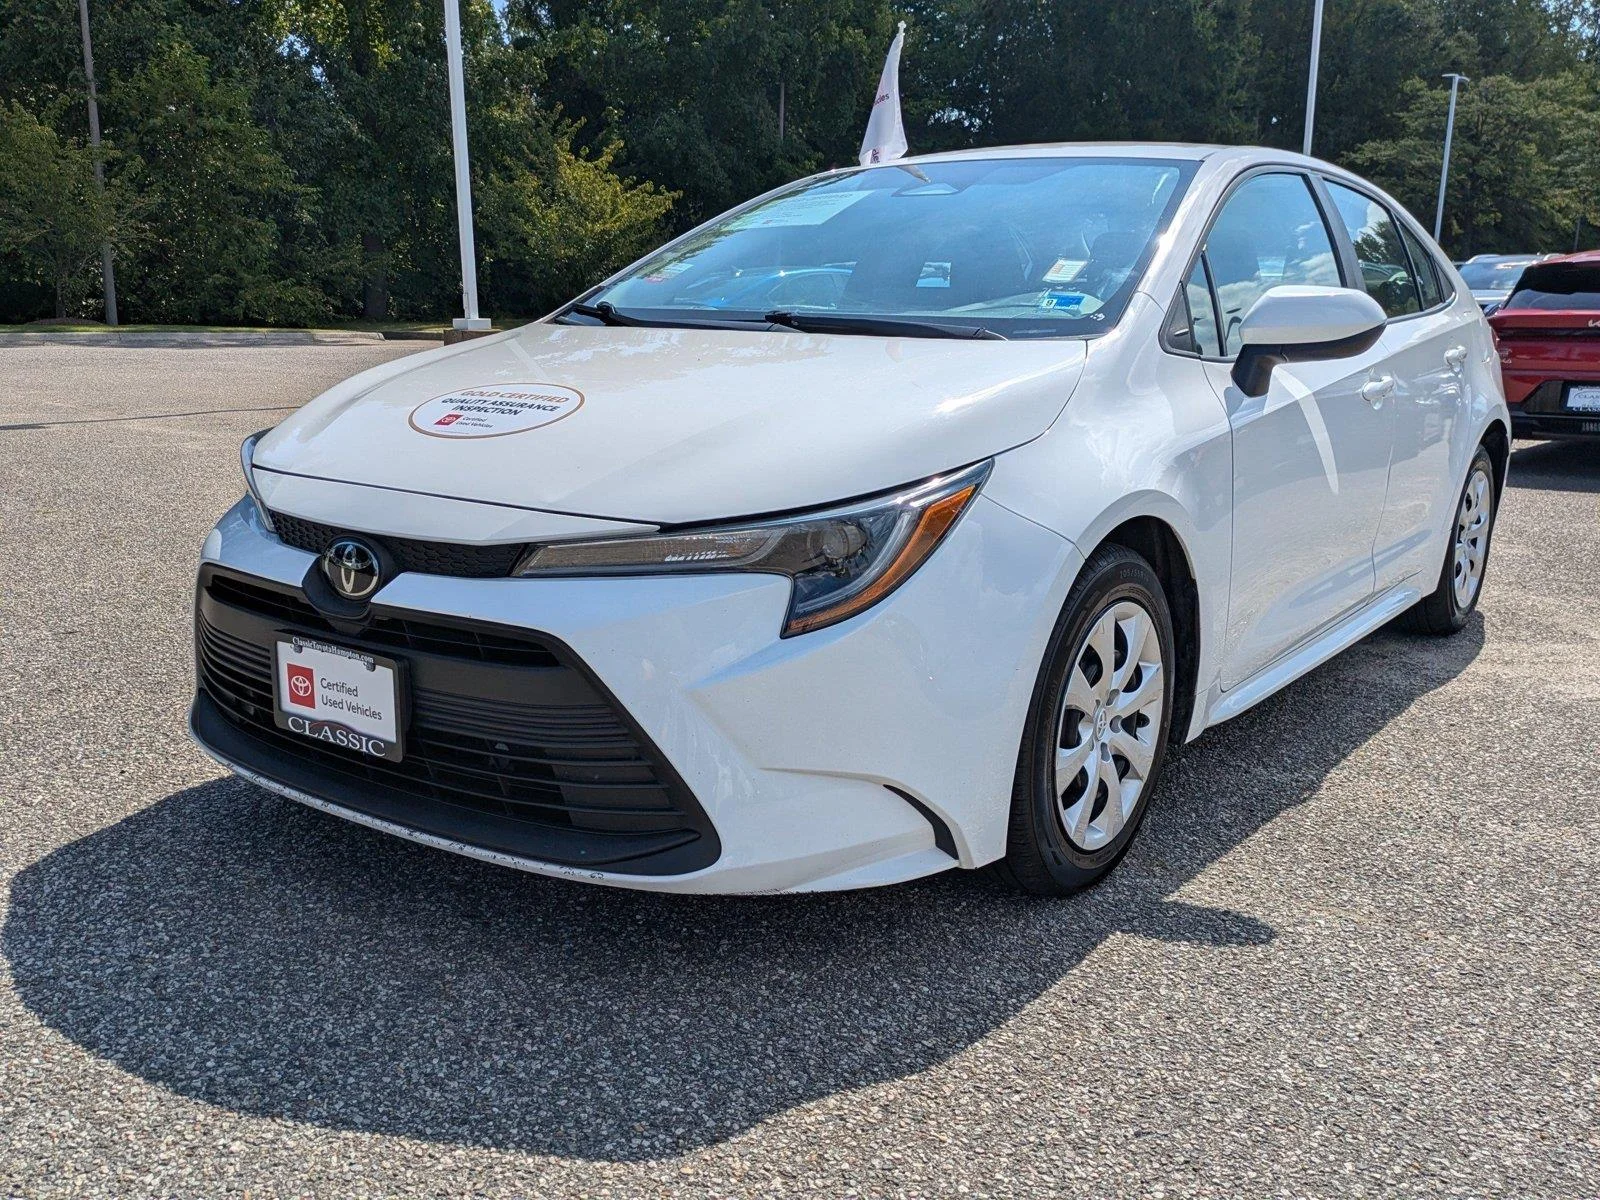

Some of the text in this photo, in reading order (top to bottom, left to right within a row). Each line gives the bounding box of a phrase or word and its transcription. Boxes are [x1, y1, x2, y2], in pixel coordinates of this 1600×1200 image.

[461, 390, 570, 403] GOLD CERTIFIED
[487, 400, 561, 412] ASSURANCE
[451, 405, 523, 416] INSPECTION
[292, 636, 375, 662] ClassicToyotaHampton.com
[320, 677, 359, 697] Certified
[321, 694, 383, 721] Used Vehicles
[288, 716, 386, 757] CLASSIC
